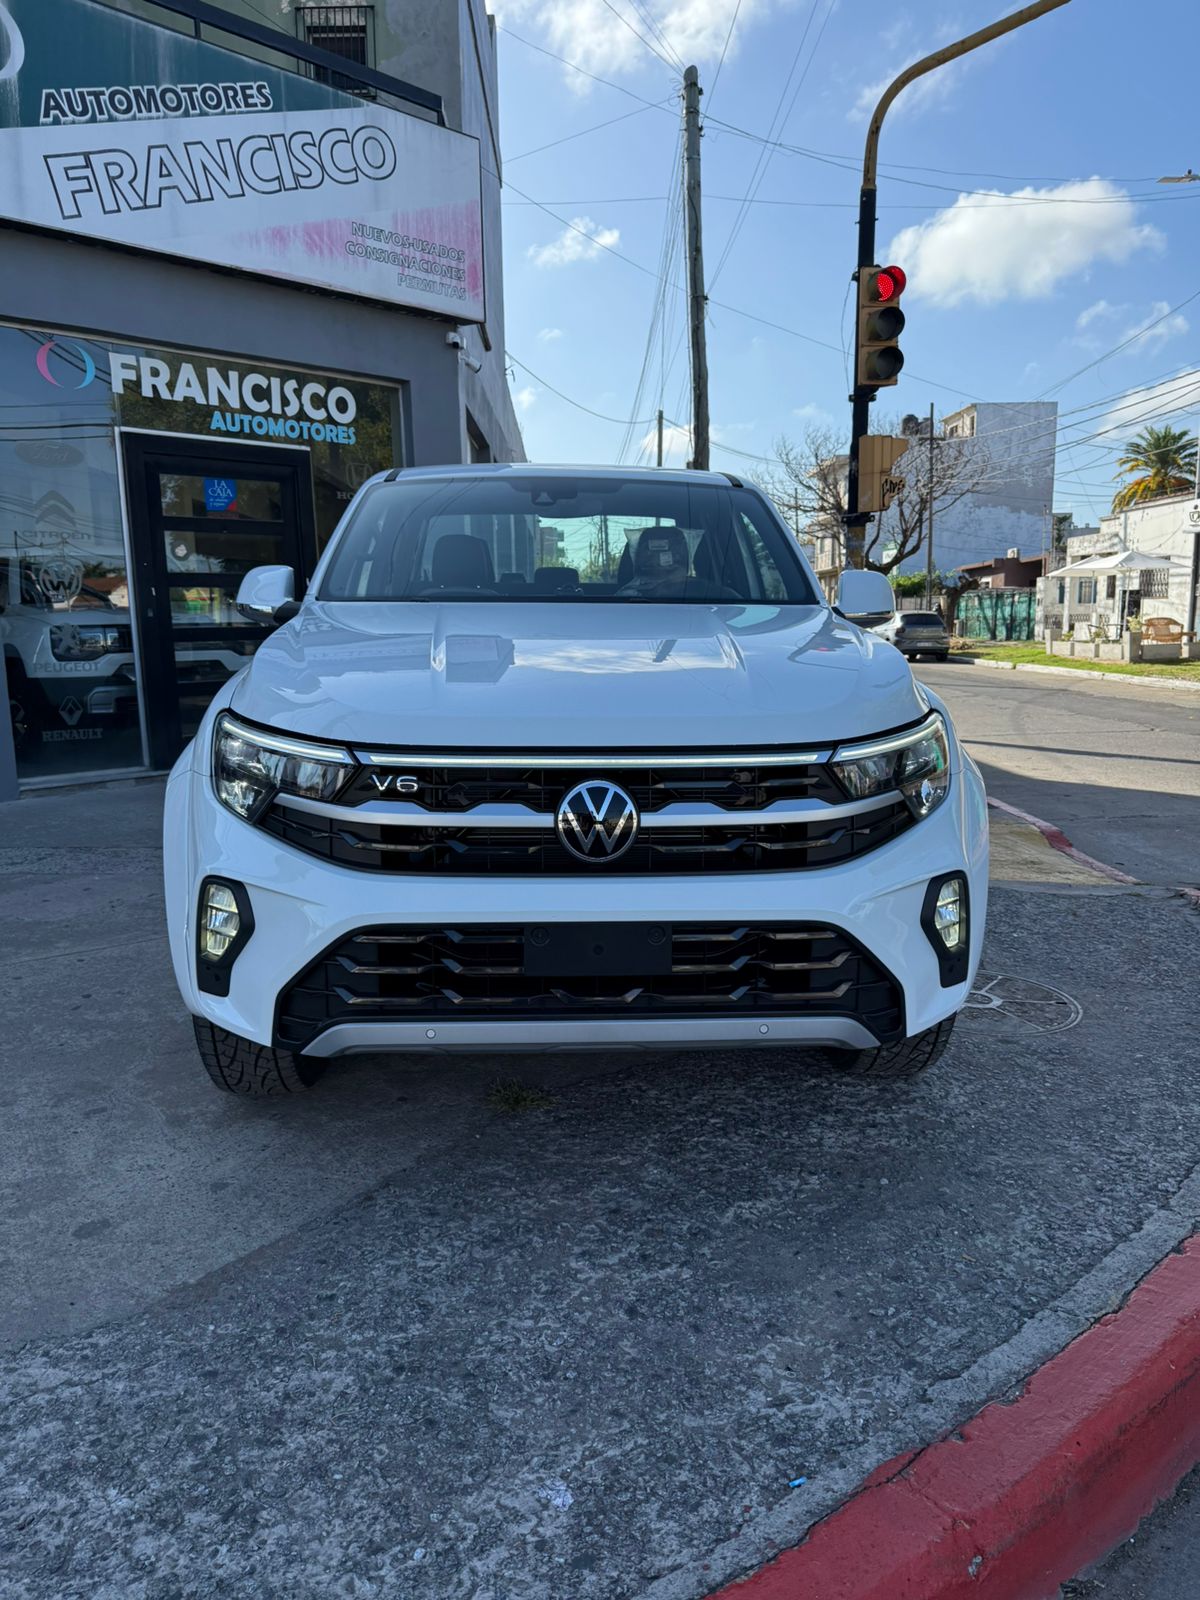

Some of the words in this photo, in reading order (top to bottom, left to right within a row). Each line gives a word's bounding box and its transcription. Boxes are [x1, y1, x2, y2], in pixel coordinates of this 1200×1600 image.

[40, 81, 273, 124] AUTOMOTORES
[43, 125, 397, 220] FRANCISCO
[344, 240, 466, 281] CONSIGNACIONES
[397, 272, 467, 300] PERMUTAS
[108, 352, 357, 425] FRANCISCO
[210, 410, 357, 446] AUTOMOTORES
[34, 660, 101, 674] PEUGEOT
[42, 727, 104, 742] RENAULT
[371, 774, 420, 793] V6
